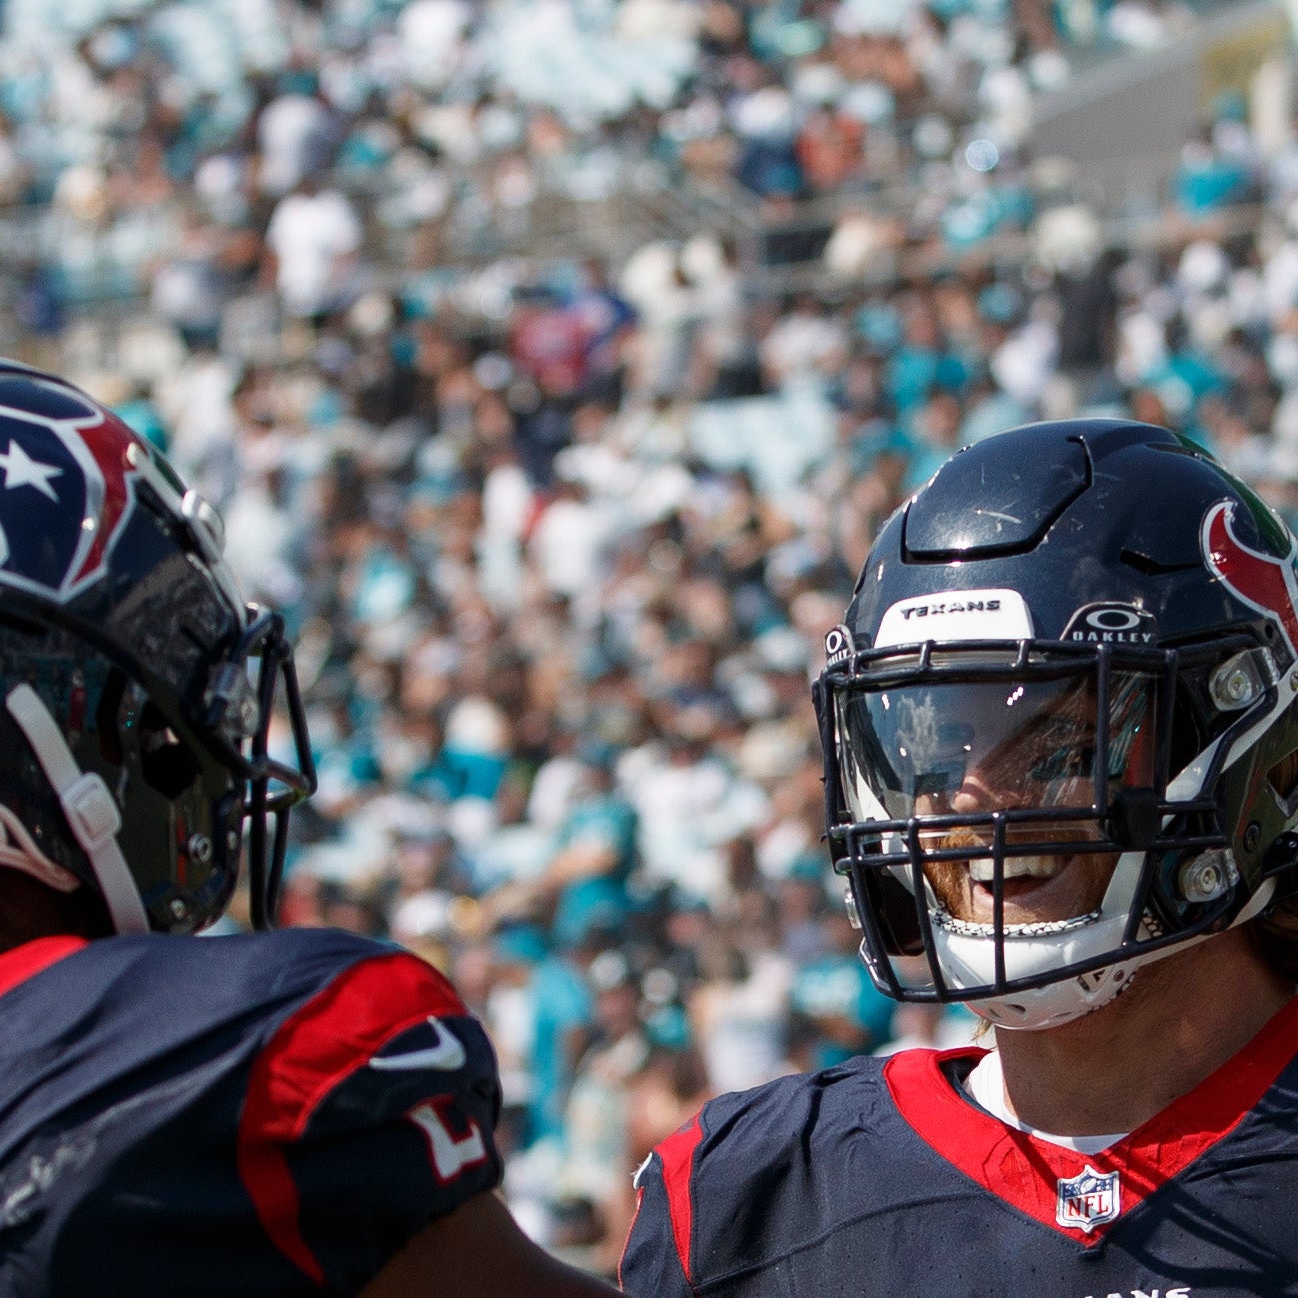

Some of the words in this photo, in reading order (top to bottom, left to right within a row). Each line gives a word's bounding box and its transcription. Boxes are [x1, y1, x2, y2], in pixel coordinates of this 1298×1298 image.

[901, 600, 1001, 620] TEXANS
[1072, 631, 1152, 643] OAKLEY
[1068, 1194, 1109, 1219] NFL
